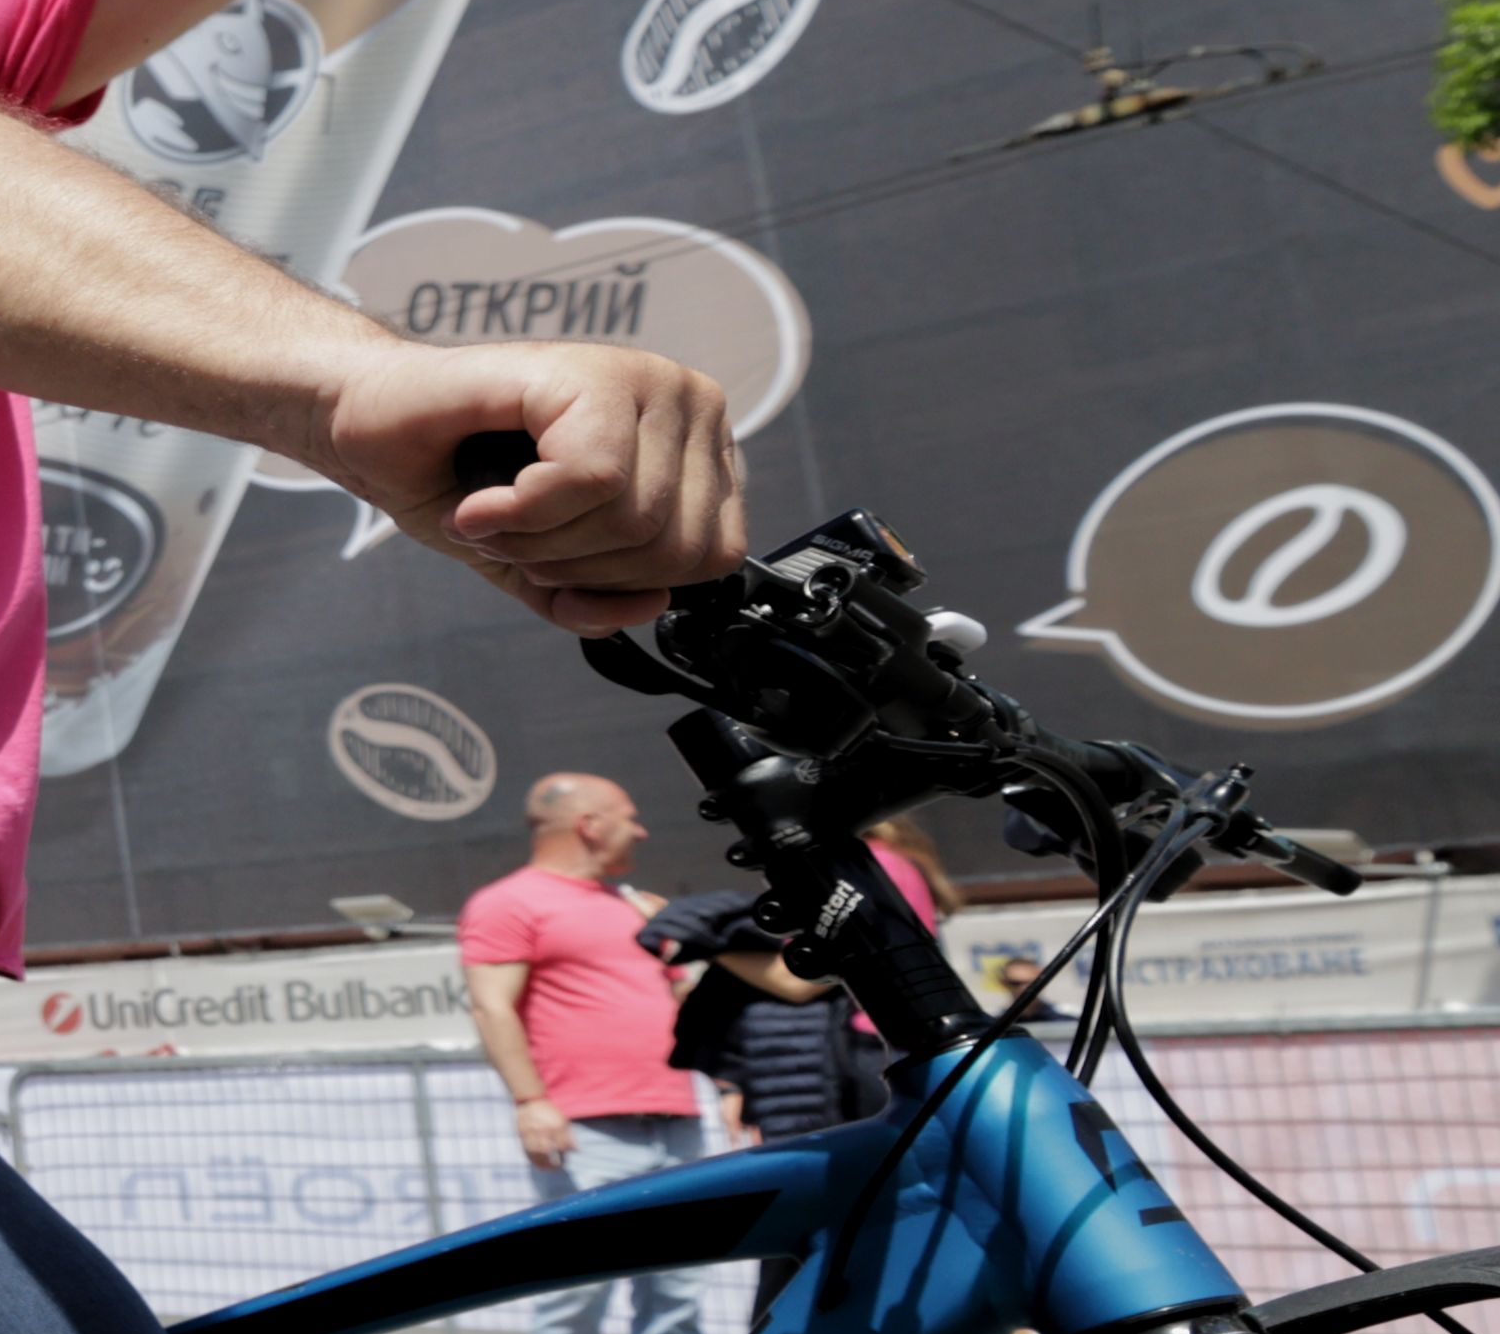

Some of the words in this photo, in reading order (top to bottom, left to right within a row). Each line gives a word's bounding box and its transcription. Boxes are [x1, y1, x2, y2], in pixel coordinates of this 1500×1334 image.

[406, 261, 649, 340] ОТКРИЙ
[814, 879, 856, 939] satori
[87, 986, 274, 1031] UniCredit
[285, 975, 472, 1023] Bulbank
